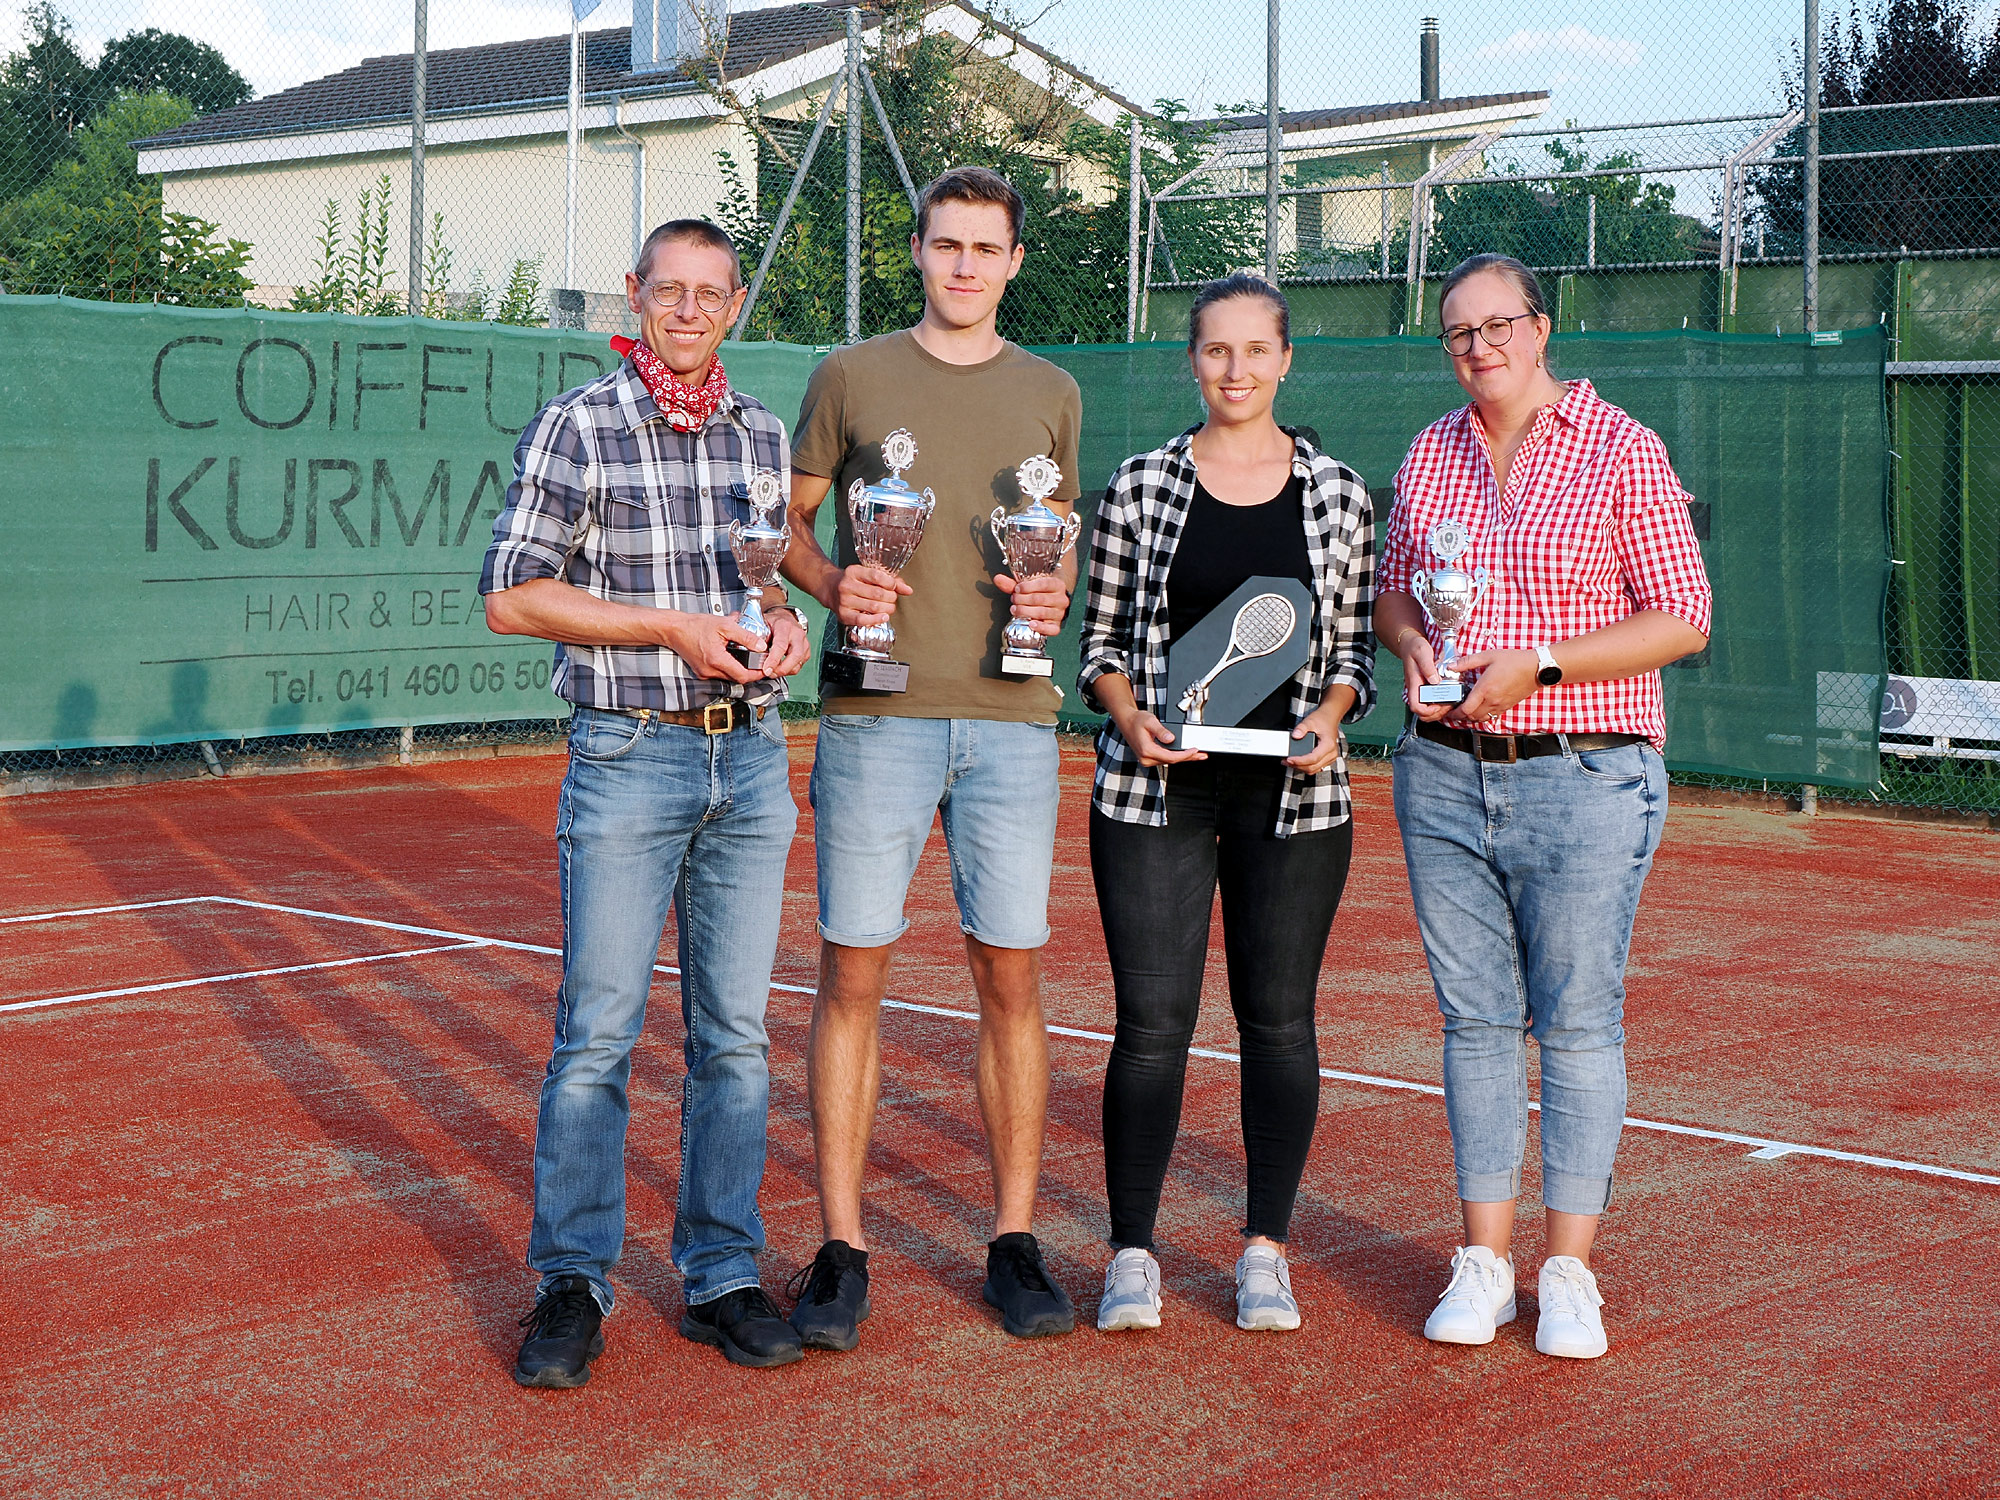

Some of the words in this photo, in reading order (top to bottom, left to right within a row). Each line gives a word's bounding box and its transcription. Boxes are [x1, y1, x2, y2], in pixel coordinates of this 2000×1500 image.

[152, 335, 625, 436] COIFFU
[245, 592, 350, 632] HAIR
[369, 591, 392, 628] &
[266, 670, 323, 704] Tel.
[336, 666, 390, 701] 041
[404, 663, 459, 697] 460
[469, 660, 505, 693] 06
[514, 659, 549, 691] 50
